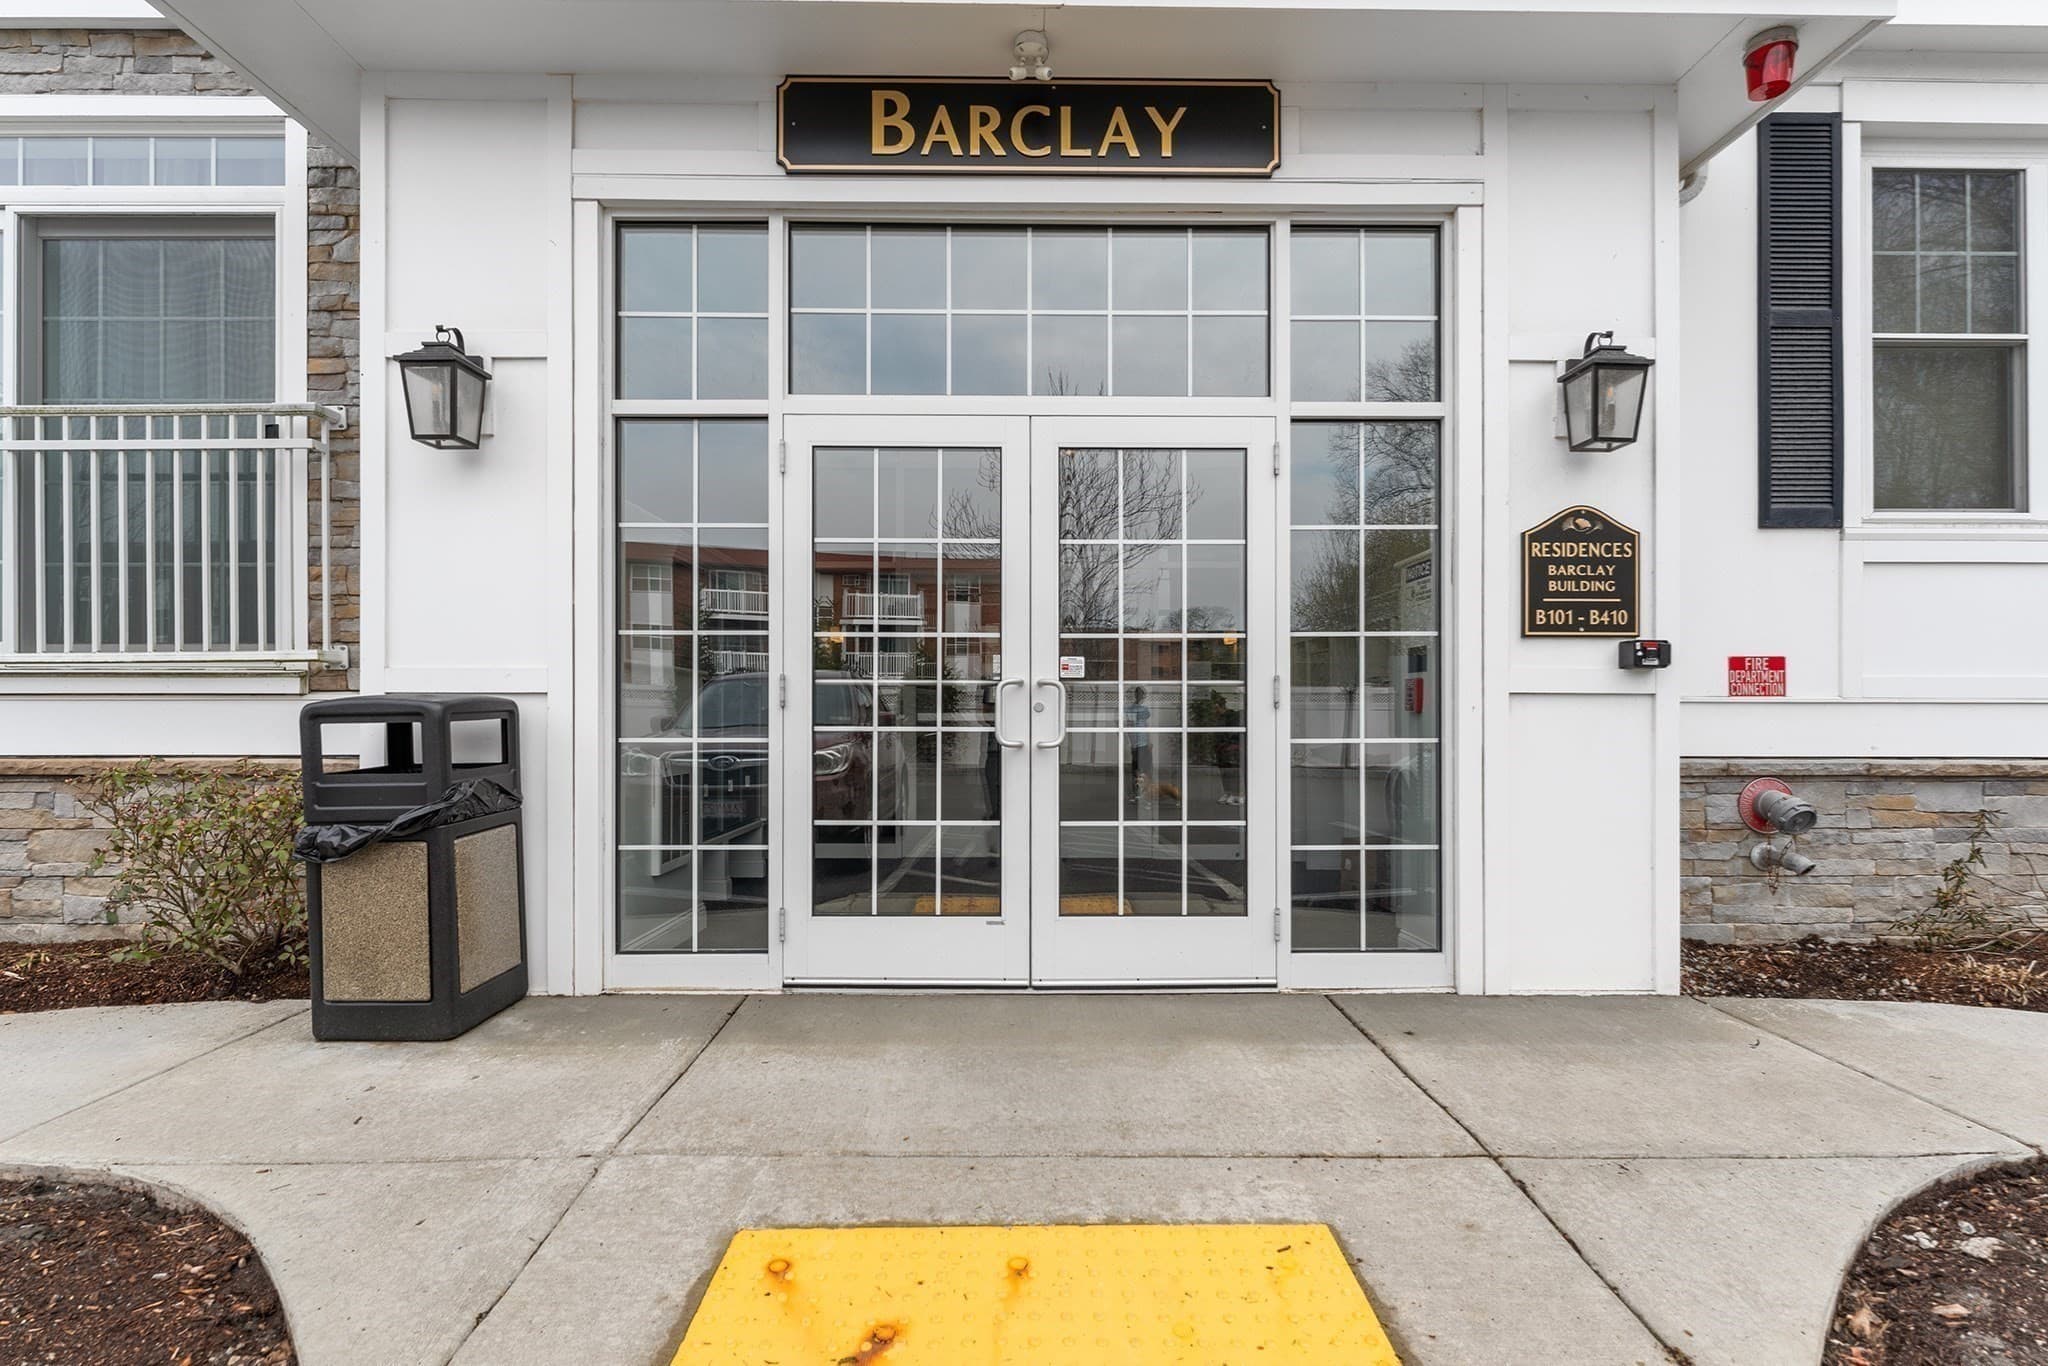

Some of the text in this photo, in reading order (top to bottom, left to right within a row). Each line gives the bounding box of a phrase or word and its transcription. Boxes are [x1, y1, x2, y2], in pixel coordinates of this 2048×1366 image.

[1531, 542, 1632, 558] RESIDENCES
[1548, 564, 1616, 576] BARCLAY
[1548, 580, 1616, 592] BUILDING
[1535, 609, 1573, 625] B101
[1589, 609, 1628, 626] B410
[1745, 657, 1769, 670] FIRE
[1730, 670, 1784, 683] DEPARTMENT
[1731, 683, 1785, 696] CONNECTION
